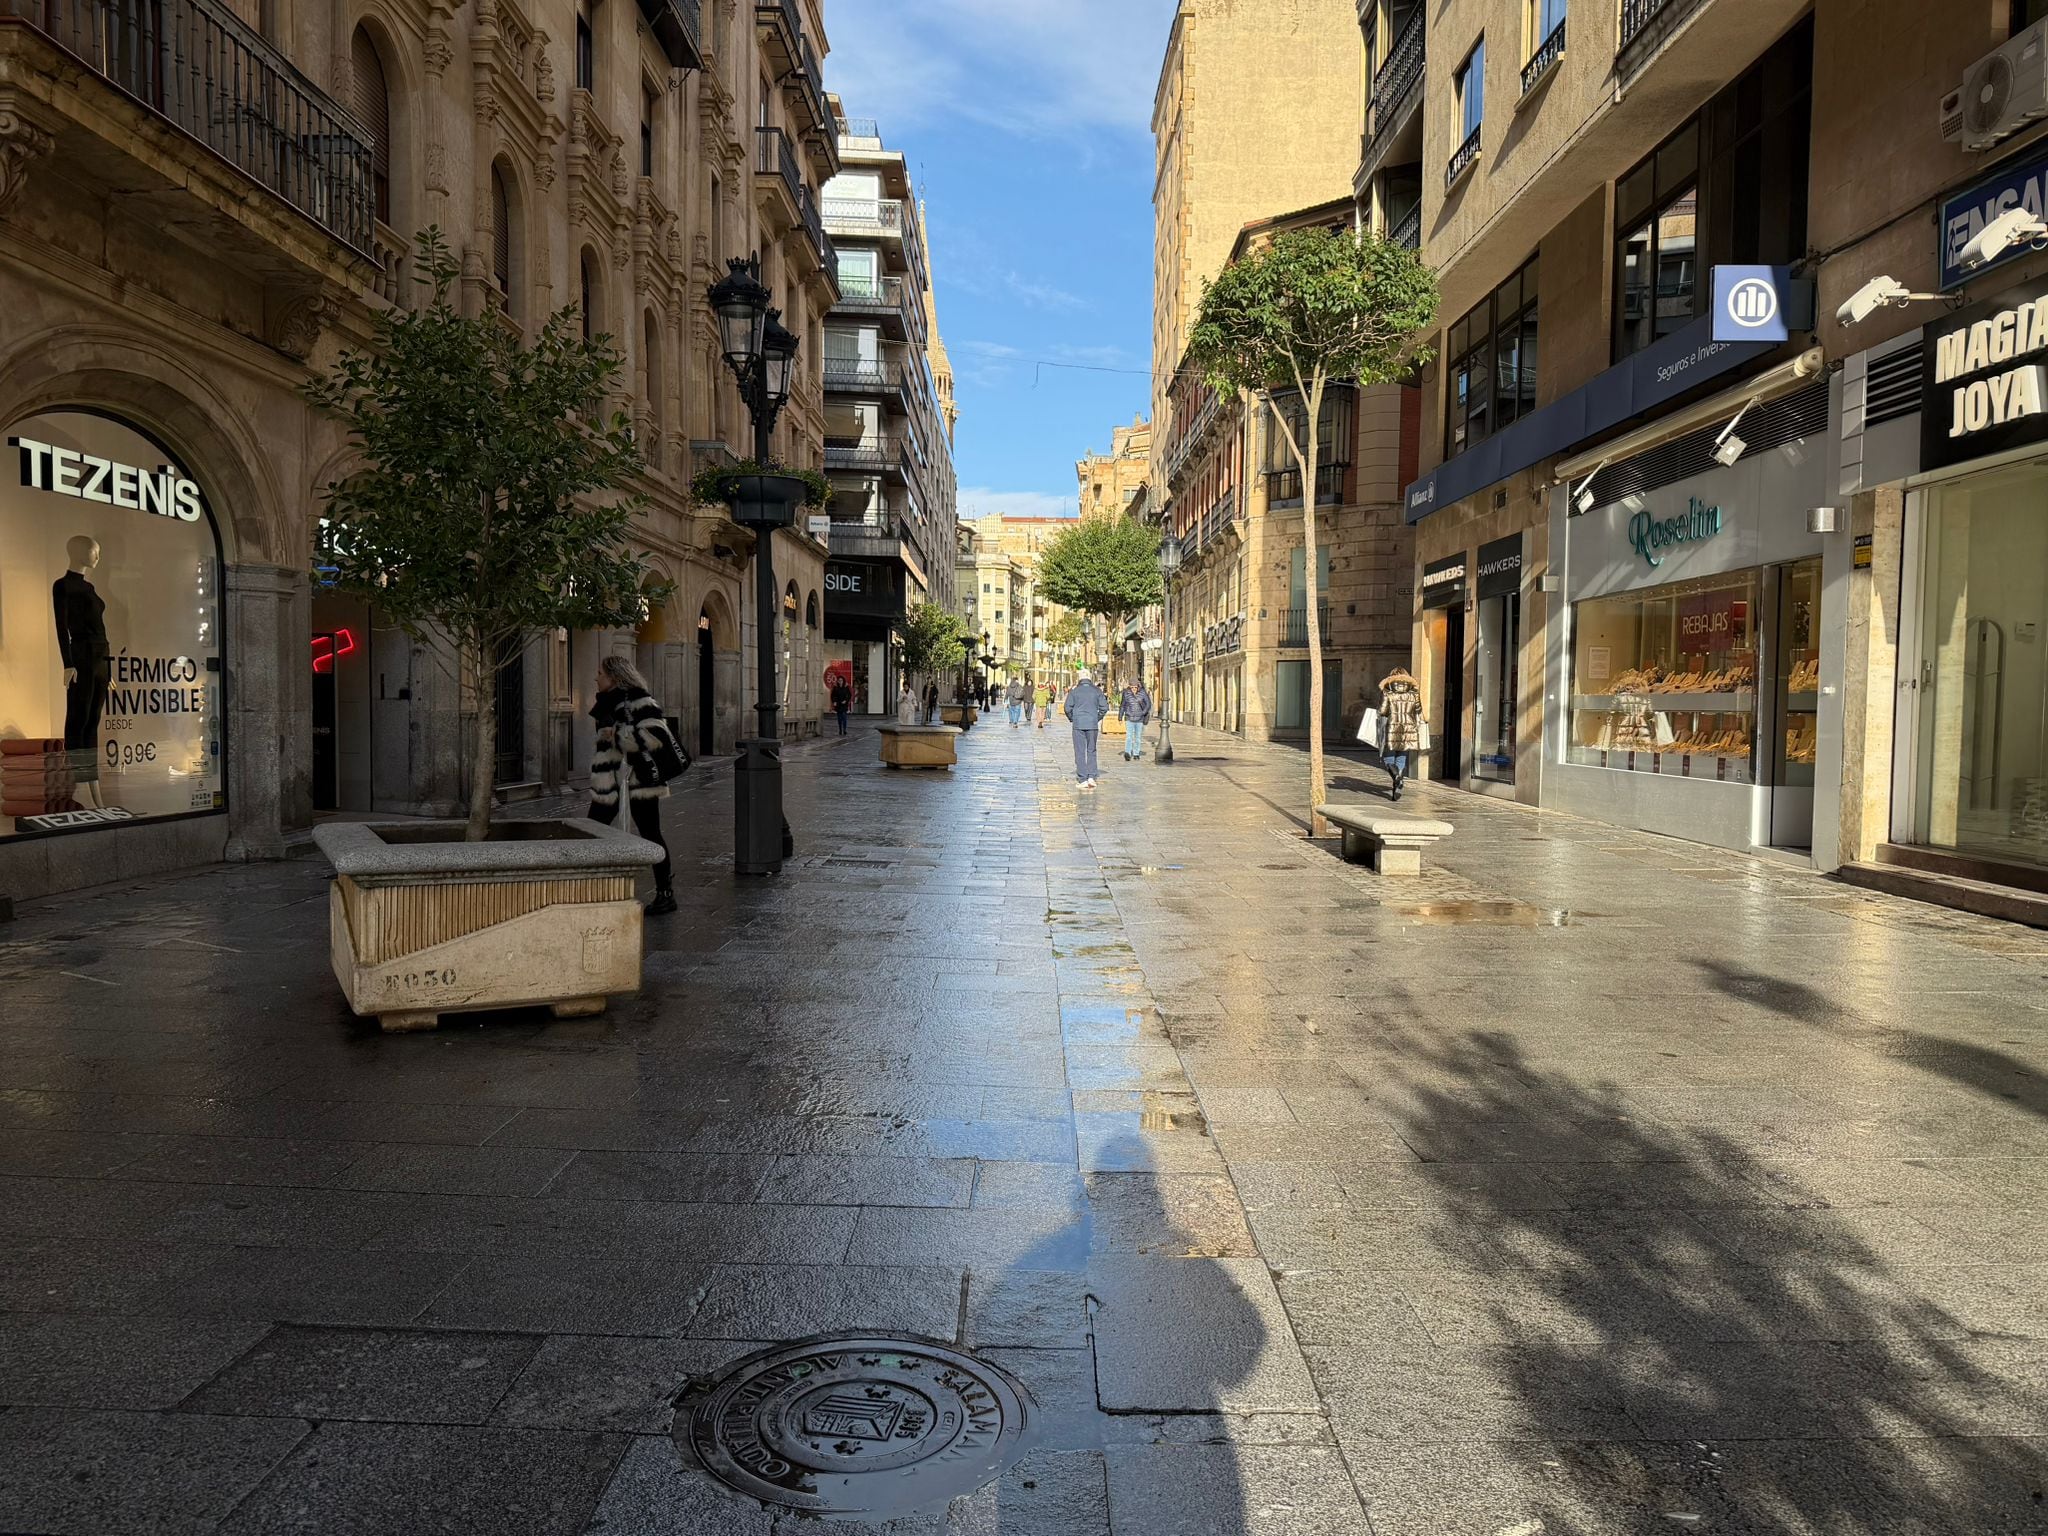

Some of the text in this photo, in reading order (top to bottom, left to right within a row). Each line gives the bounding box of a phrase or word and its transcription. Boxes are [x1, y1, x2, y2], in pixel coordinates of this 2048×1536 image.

[1946, 169, 2048, 270] ENSA
[1935, 294, 2048, 384] MAGIA
[1657, 356, 1689, 382] Seguros
[1689, 353, 1697, 365] e
[1949, 365, 2037, 437] JOYA
[1410, 490, 1428, 508] Allianz
[1628, 496, 1722, 566] Roselin
[1423, 565, 1465, 587] HAWKERS
[1477, 554, 1521, 577] HAWKERS
[825, 573, 861, 592] SIDE
[1682, 611, 1729, 635] REBAJAS
[104, 646, 197, 683] TÉRMICO
[105, 688, 201, 715] INVISIBLE
[105, 719, 133, 730] DESDE
[106, 739, 157, 767] 9,99€
[24, 807, 133, 829] TEZENIS
